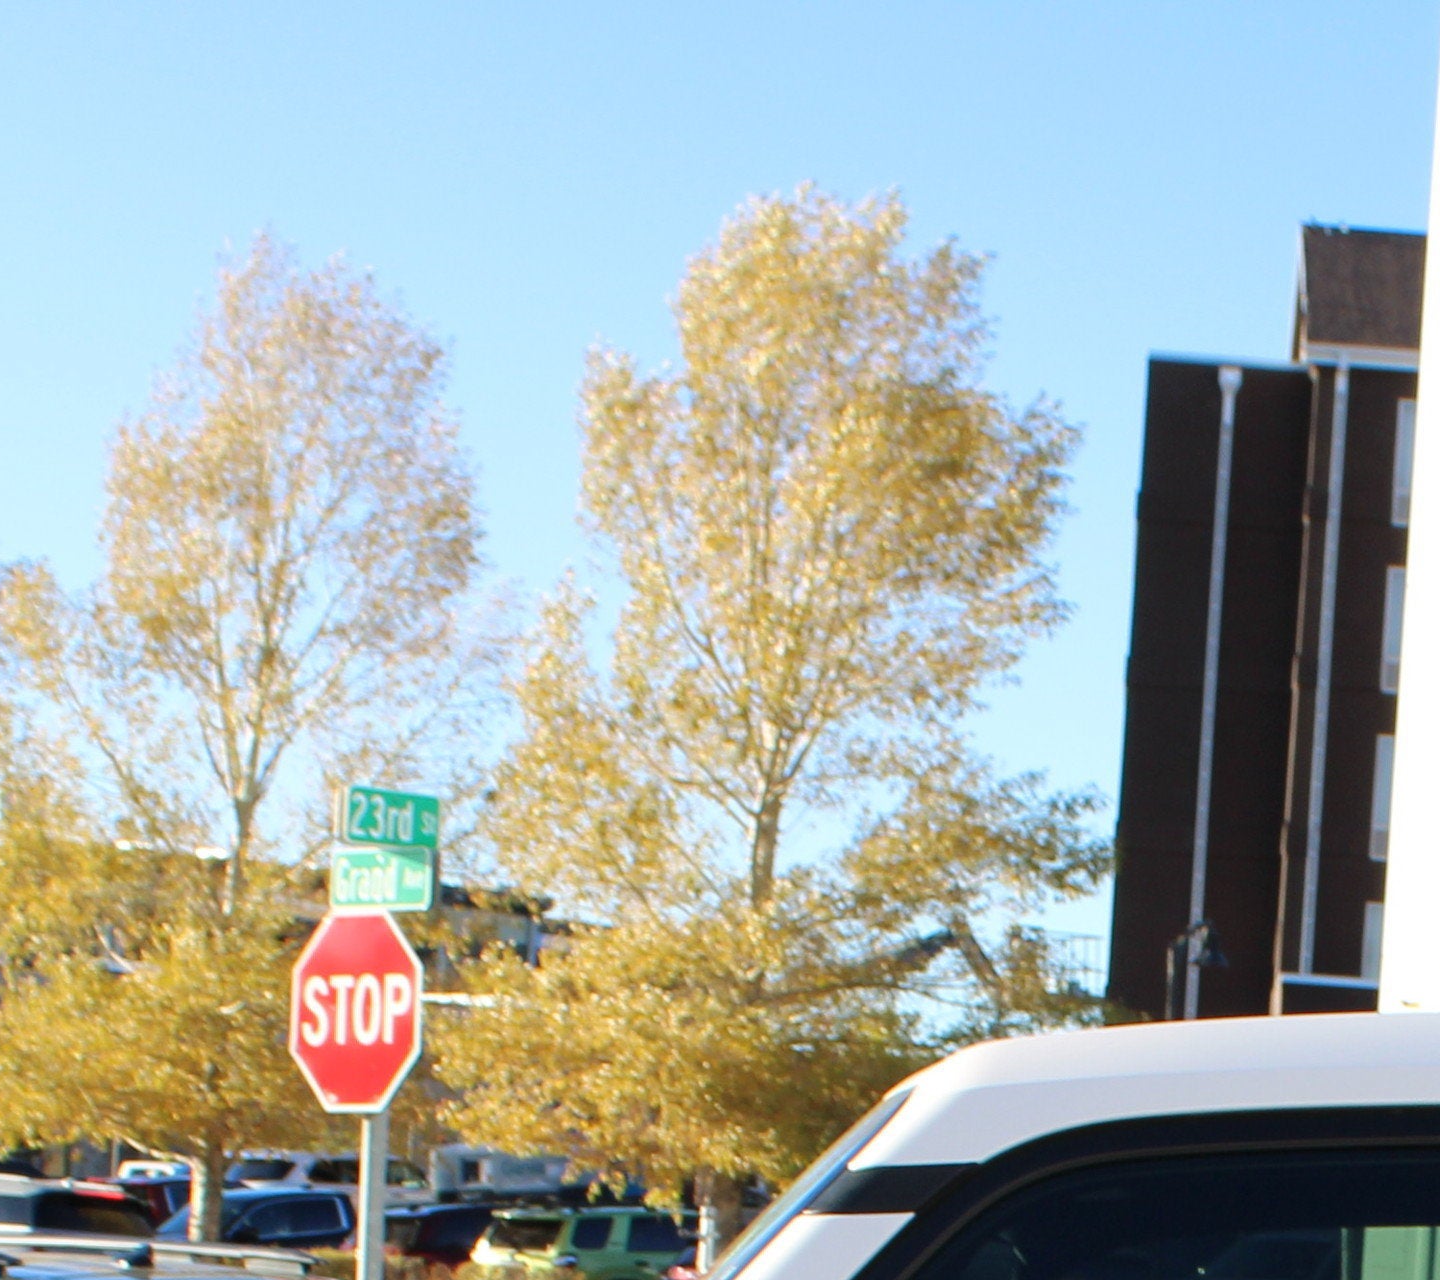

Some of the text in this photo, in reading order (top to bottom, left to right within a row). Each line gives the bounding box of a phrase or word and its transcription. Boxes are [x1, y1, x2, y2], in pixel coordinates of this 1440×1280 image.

[350, 791, 414, 844] 23rd
[334, 857, 399, 903] Grand
[301, 972, 413, 1048] STOP
